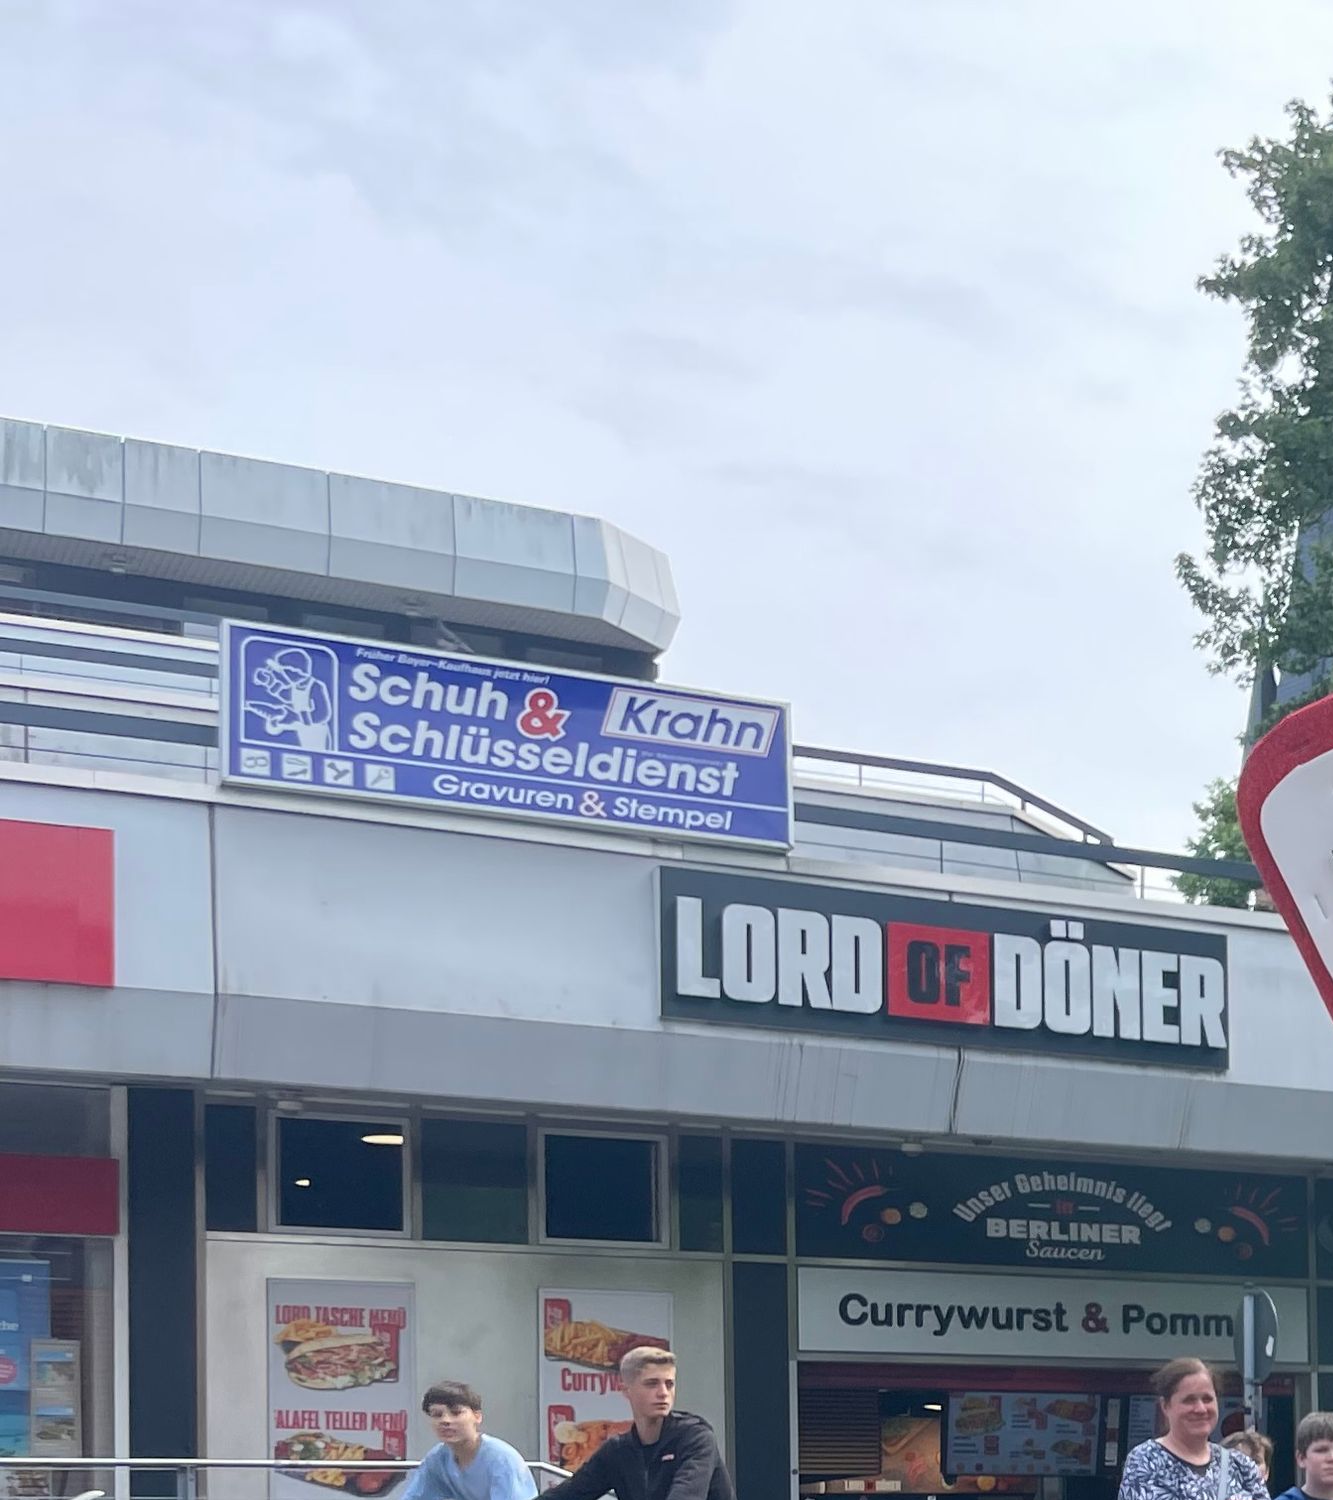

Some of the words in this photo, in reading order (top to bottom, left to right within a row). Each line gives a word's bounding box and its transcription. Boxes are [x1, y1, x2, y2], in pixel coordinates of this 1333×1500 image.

[349, 663, 509, 720] Schuh
[517, 687, 571, 742] &
[619, 697, 765, 749] Krahn
[349, 712, 739, 796] Schlüsseldienst
[433, 774, 574, 810] Gravuren
[579, 791, 607, 817] &
[613, 797, 733, 830] Stempel
[676, 896, 883, 1014] LORD
[907, 940, 971, 1006] OF
[994, 920, 1227, 1048] DÖNER
[952, 1181, 1012, 1223] Unser
[1015, 1171, 1128, 1203] Geheimnis
[986, 1218, 1141, 1245] BERLINER
[1026, 1240, 1105, 1261] Saucen
[315, 1306, 365, 1328] TASCHE
[838, 1293, 1069, 1336] Currywurst
[1081, 1302, 1109, 1334] &
[1122, 1303, 1233, 1337] Pomm
[561, 1368, 629, 1395] Curryw
[275, 1410, 320, 1430] ALAFEL
[325, 1410, 367, 1431] TELLER
